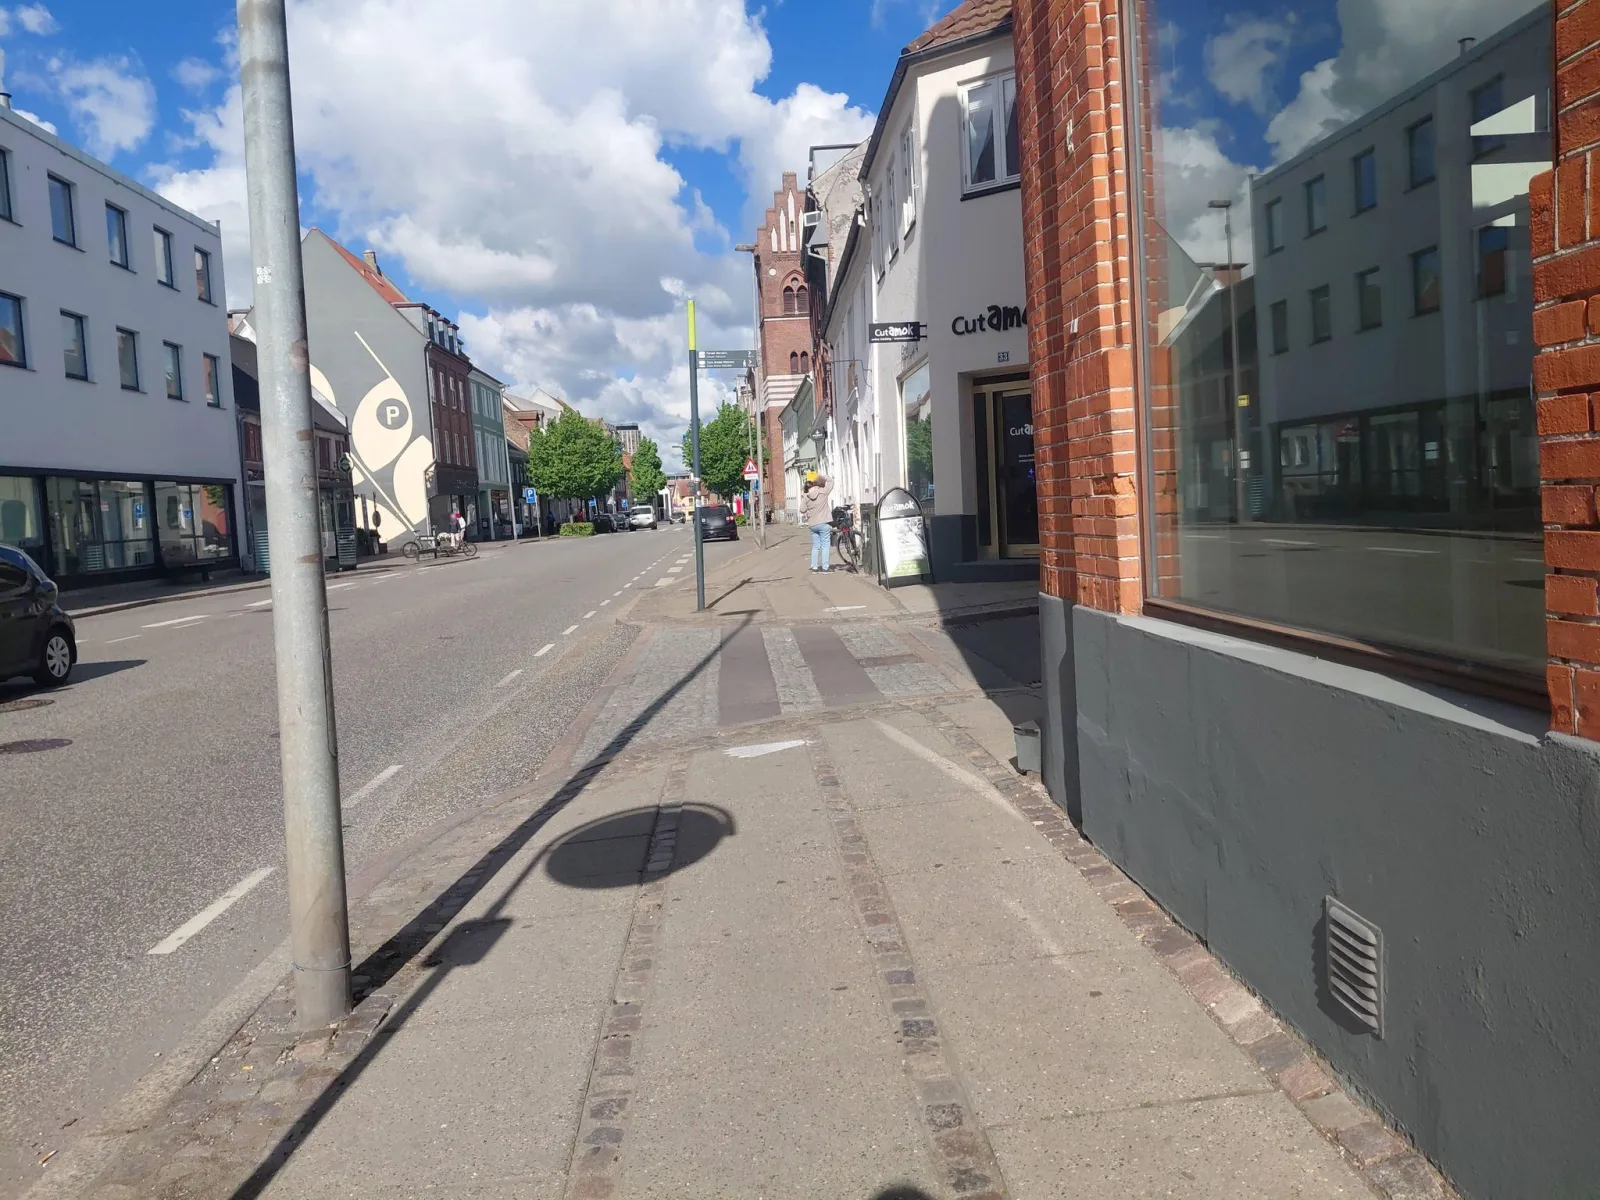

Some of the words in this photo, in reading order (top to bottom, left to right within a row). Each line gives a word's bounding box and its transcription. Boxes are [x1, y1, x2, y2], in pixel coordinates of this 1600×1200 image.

[874, 323, 914, 337] Cutamok
[998, 352, 1008, 361] 33
[385, 405, 400, 425] P
